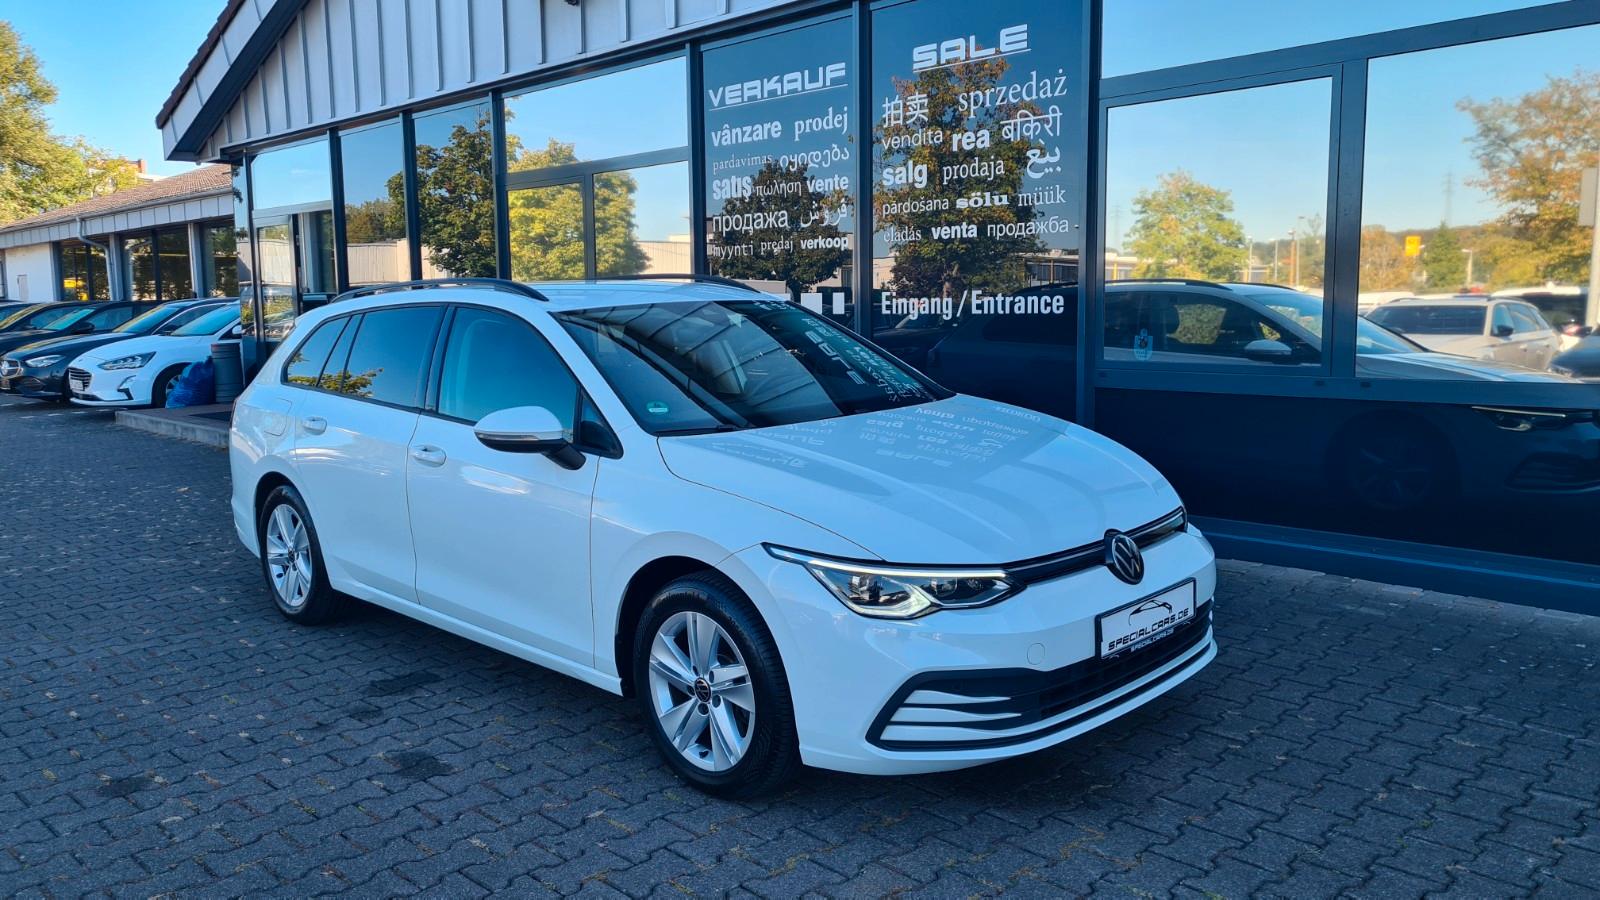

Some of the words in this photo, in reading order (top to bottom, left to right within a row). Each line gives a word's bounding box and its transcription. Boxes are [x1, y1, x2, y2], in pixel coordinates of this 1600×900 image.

[912, 24, 1028, 70] SALE
[708, 62, 846, 107] VERKAUF
[958, 68, 1067, 119] sprzedaż
[882, 91, 929, 128] 拍卖
[711, 123, 782, 147] vânzare
[794, 106, 848, 142] prodej
[882, 127, 943, 150] vendita
[952, 129, 990, 151] rea
[713, 154, 773, 175] pardavimas
[882, 160, 928, 188] salg
[943, 156, 1005, 184] prodaja
[1026, 146, 1062, 179] بيع
[712, 175, 752, 202] satış
[807, 174, 849, 193] vente
[956, 191, 1010, 209] sölu
[1018, 185, 1066, 207] müük
[712, 209, 789, 237] продажа
[883, 226, 922, 242] eladás
[931, 222, 978, 240] venta
[987, 216, 1069, 240] продажба
[713, 241, 754, 260] myynti
[760, 236, 794, 255] predaj
[800, 235, 849, 251] verkoop
[881, 291, 952, 320] Eingang
[956, 290, 967, 317] /
[971, 289, 1064, 314] Entrance
[1108, 607, 1189, 651] SPECIALCARS.DE
